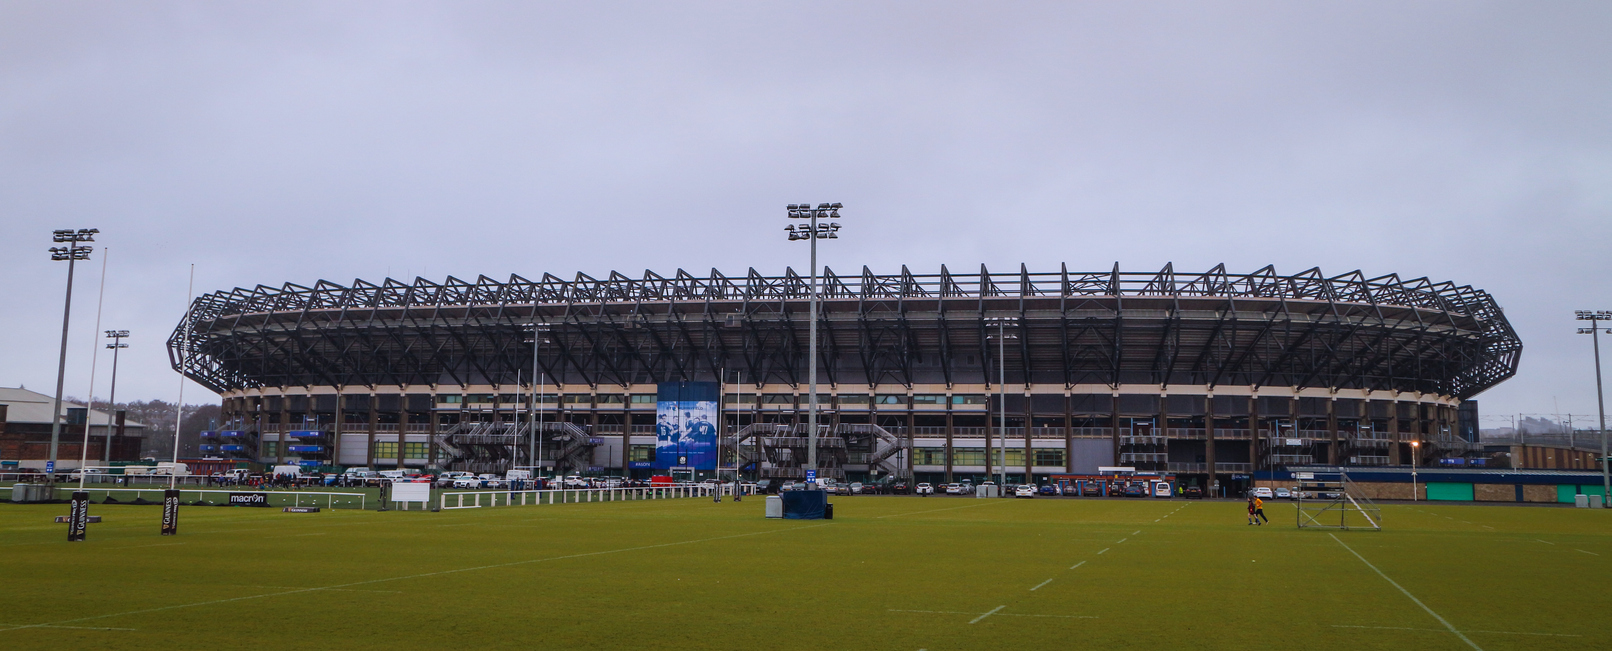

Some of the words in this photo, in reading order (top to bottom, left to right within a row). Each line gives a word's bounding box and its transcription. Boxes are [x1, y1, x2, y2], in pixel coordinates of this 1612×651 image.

[163, 496, 172, 525] GUINNESS
[230, 494, 264, 503] macron
[77, 499, 87, 529] GUINNESS
